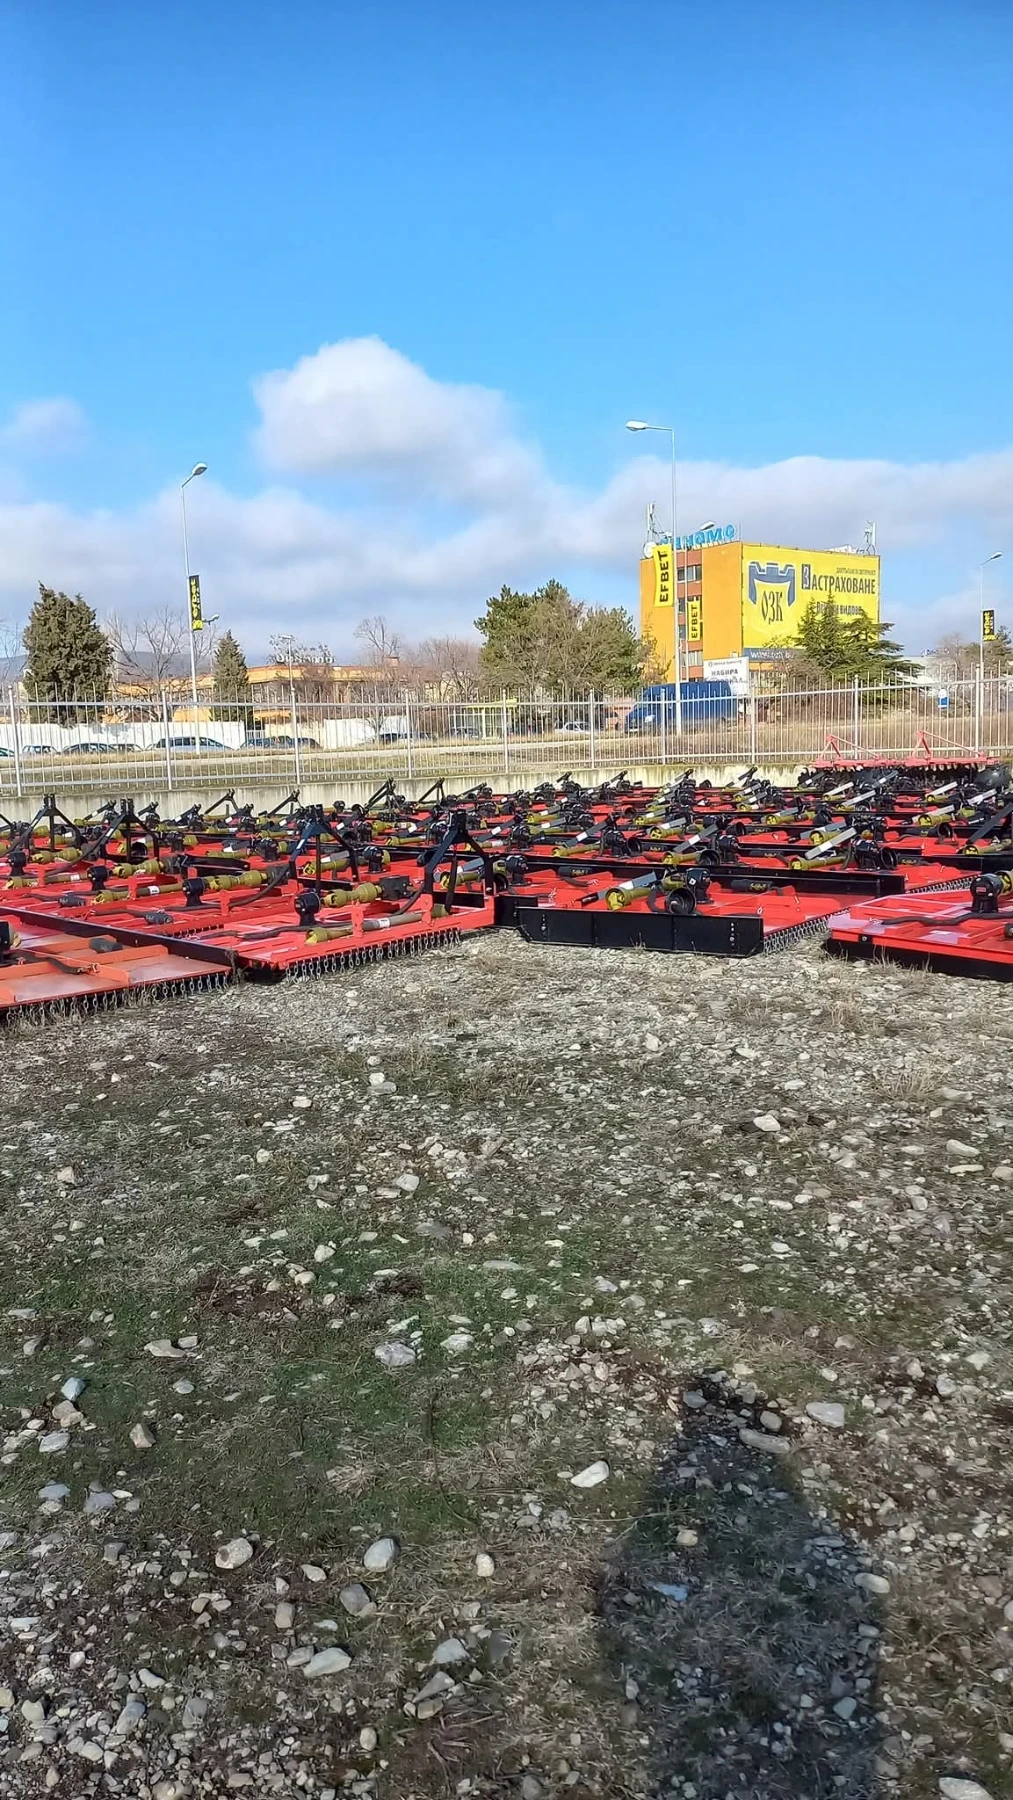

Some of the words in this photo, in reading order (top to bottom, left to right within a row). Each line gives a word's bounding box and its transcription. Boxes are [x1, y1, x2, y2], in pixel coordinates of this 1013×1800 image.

[657, 550, 669, 603] EFBET
[802, 564, 876, 595] ЗАСТРАХОВАНЕ
[690, 604, 698, 639] EFBET
[761, 590, 783, 625] ОЗК
[711, 668, 739, 676] НАБИРА
